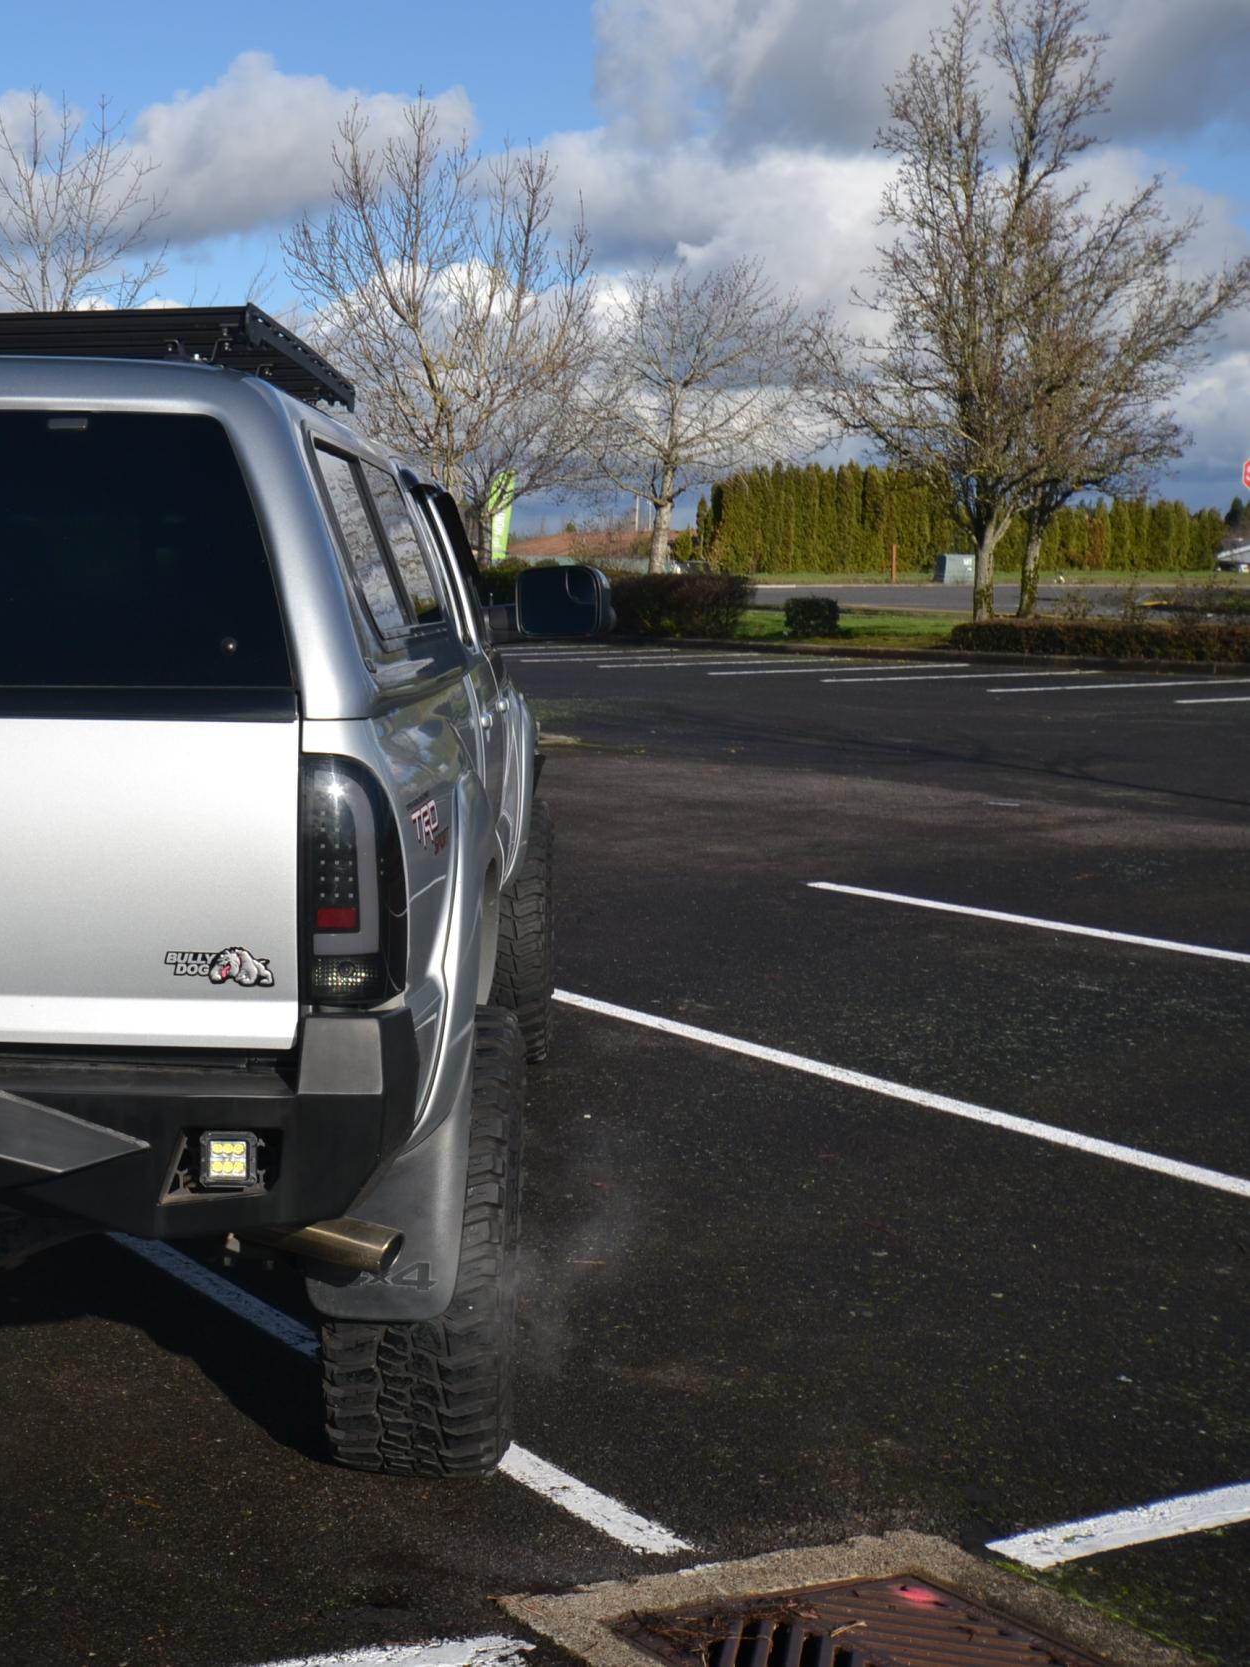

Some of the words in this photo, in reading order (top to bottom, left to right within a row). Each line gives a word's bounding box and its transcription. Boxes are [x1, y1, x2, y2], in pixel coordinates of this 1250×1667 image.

[411, 799, 439, 847] TRD
[165, 952, 216, 965] BULLY
[175, 963, 210, 976] DOG
